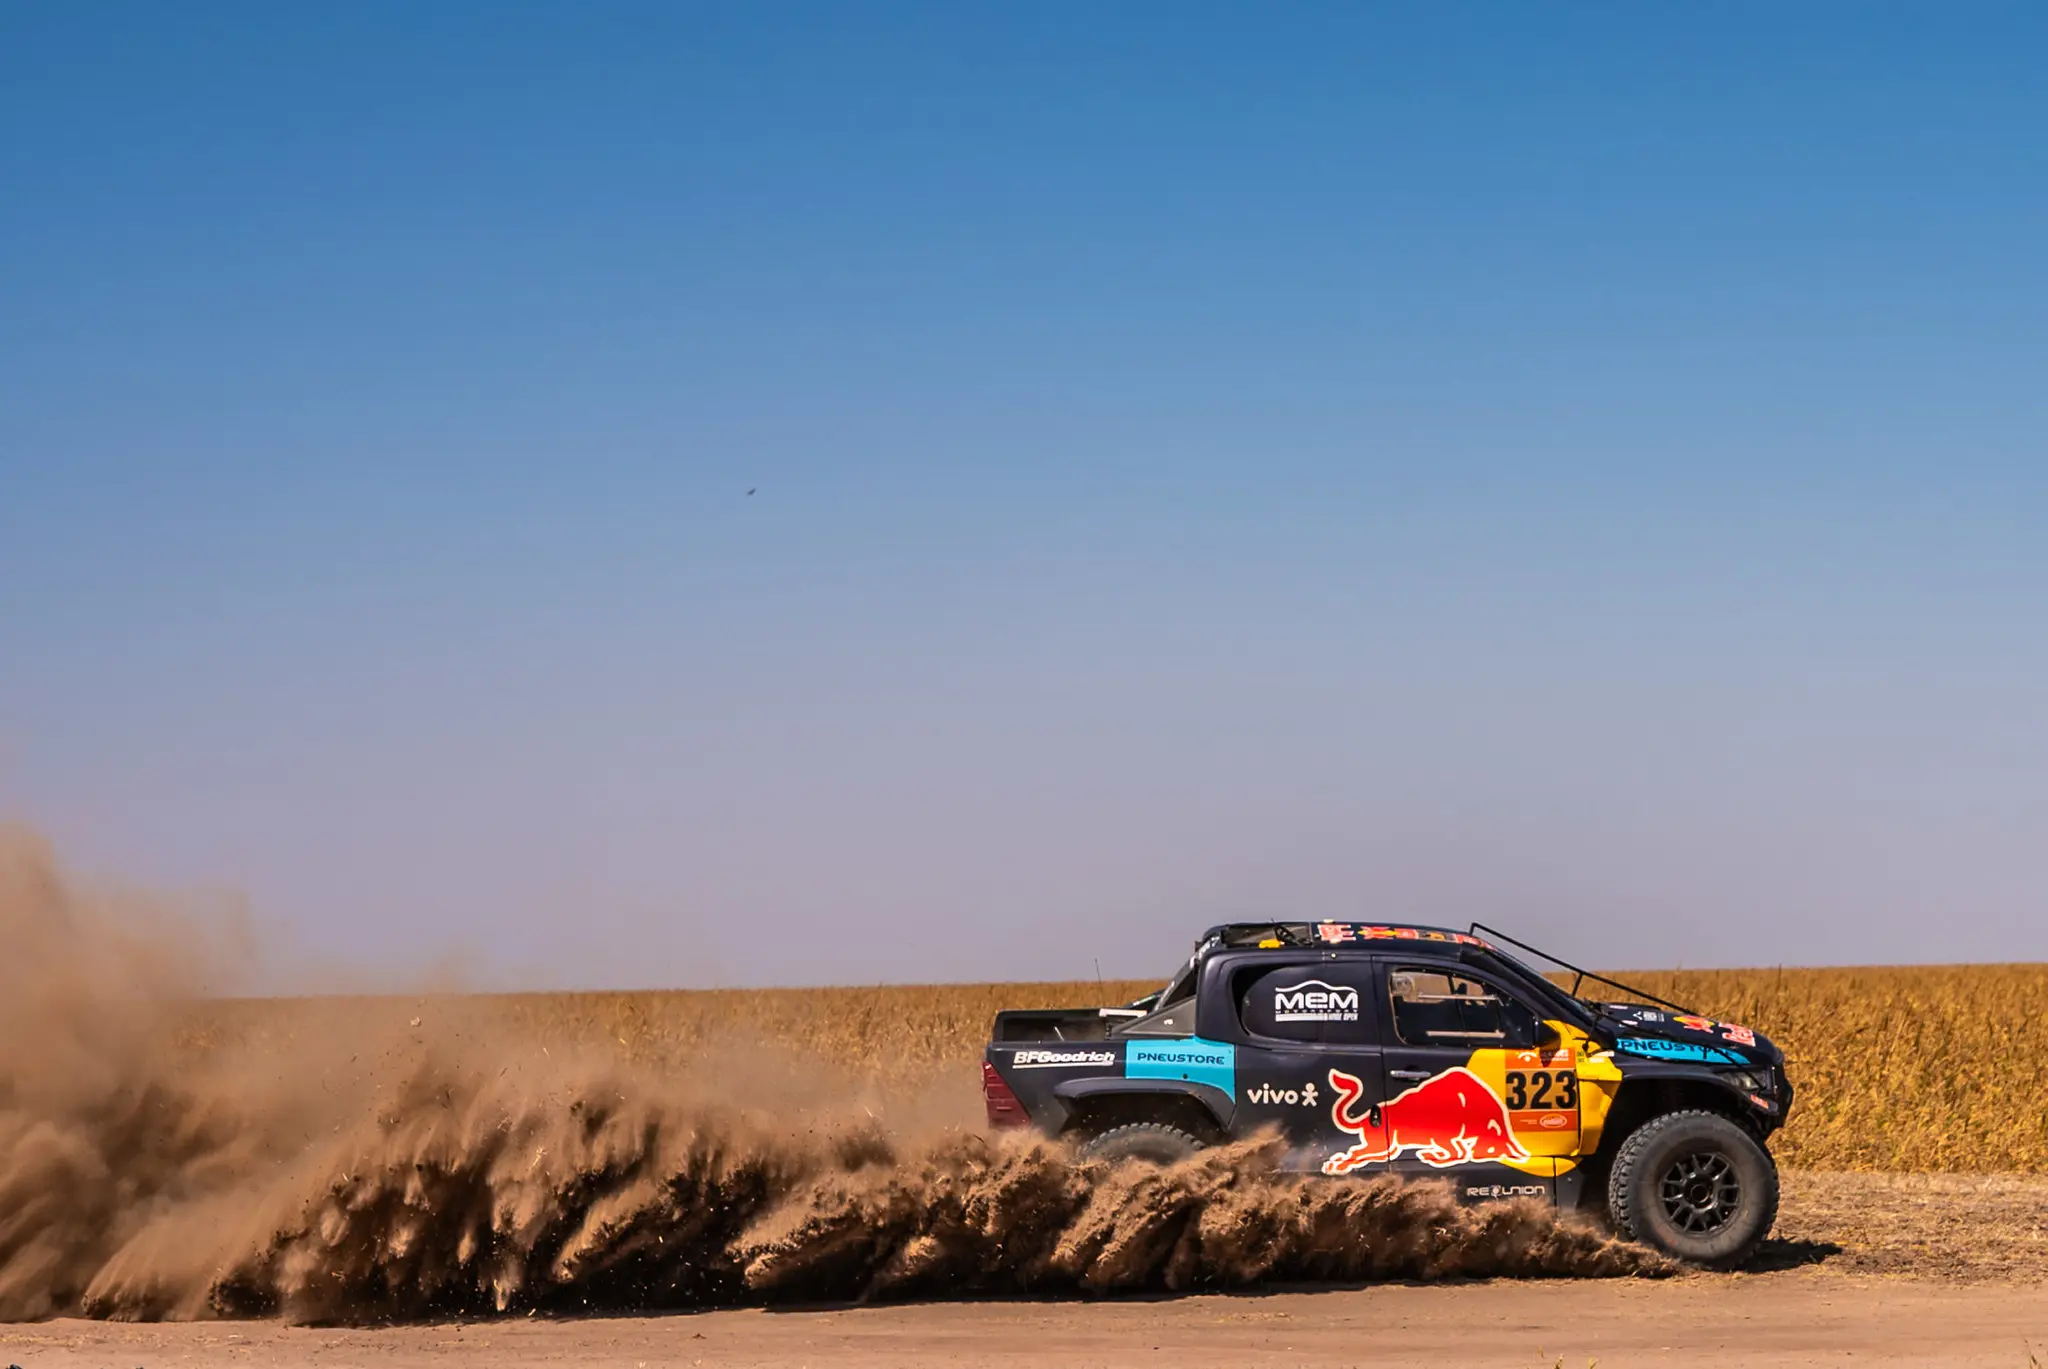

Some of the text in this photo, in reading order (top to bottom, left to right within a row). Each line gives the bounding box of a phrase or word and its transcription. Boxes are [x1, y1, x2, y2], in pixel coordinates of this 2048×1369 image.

[1622, 1040, 1733, 1056] PNEUSTO
[1013, 1051, 1115, 1064] BFGoodrich
[1137, 1052, 1225, 1065] PNEUSTORE
[1247, 1083, 1299, 1105] vivo
[1505, 1070, 1577, 1110] 323
